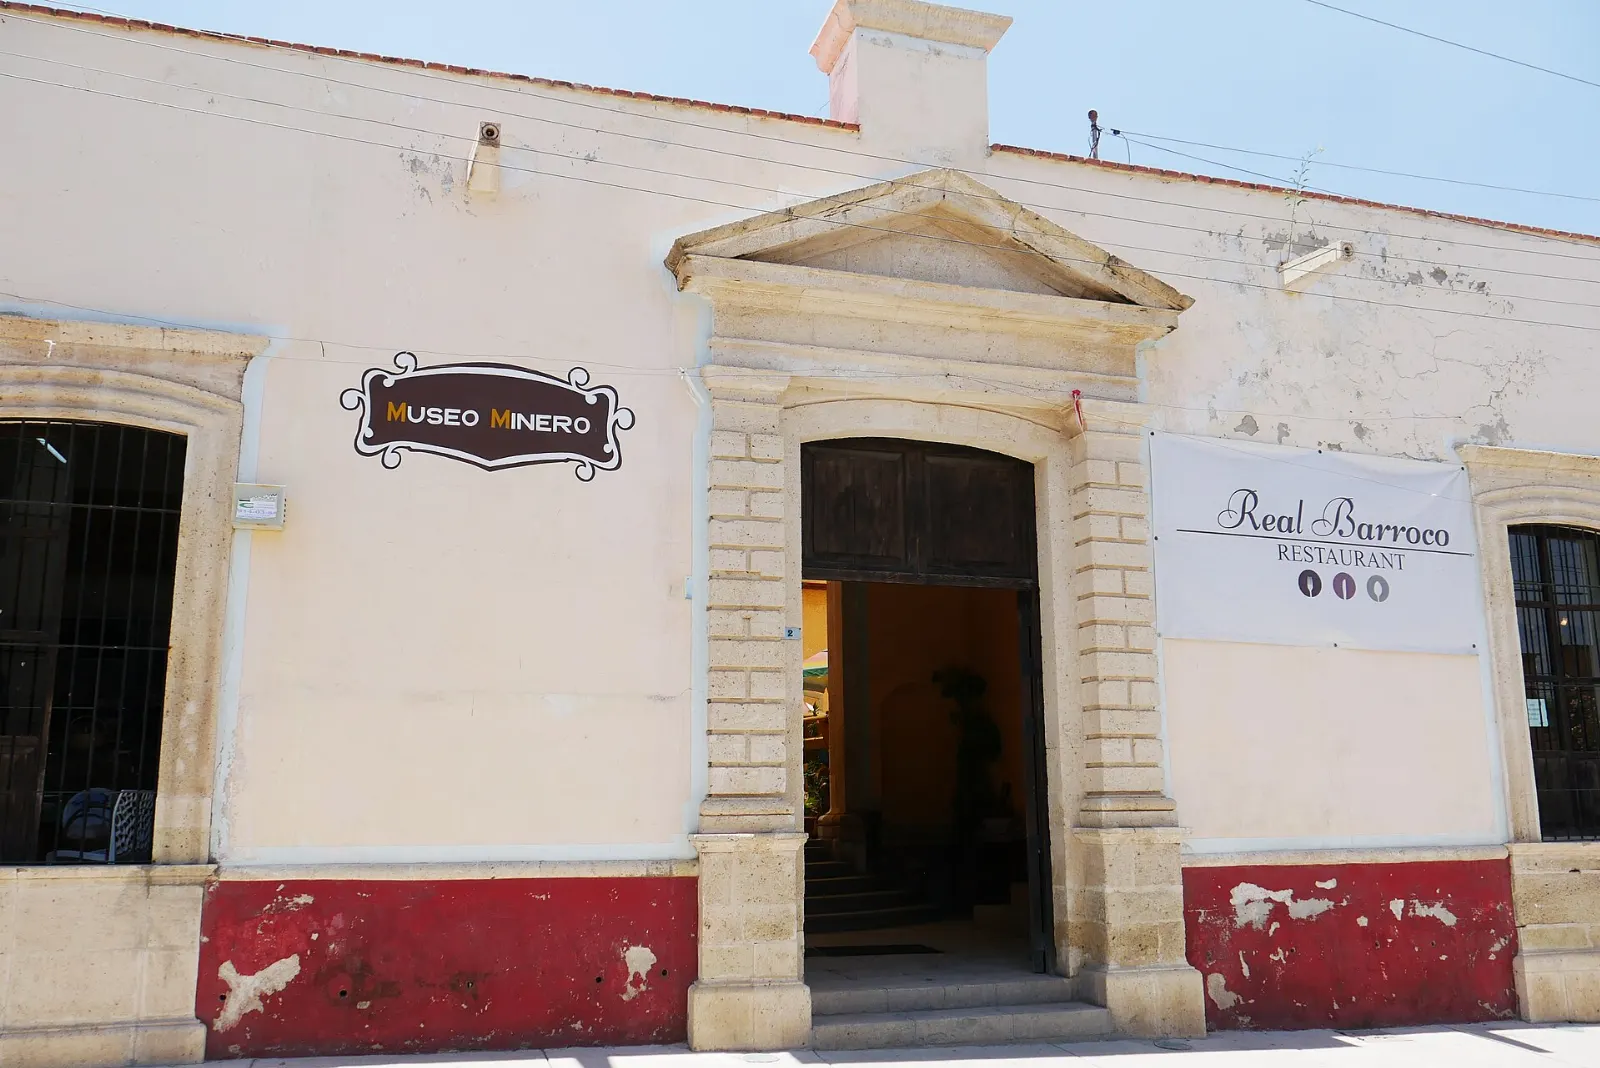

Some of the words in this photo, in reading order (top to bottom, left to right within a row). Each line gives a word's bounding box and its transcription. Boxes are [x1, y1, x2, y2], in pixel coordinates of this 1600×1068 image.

[387, 401, 479, 427] MUSEO
[490, 408, 591, 434] MINERO
[1217, 488, 1303, 535] Real
[1311, 497, 1450, 547] Barroco
[1277, 543, 1405, 571] RESTAURANT
[787, 629, 794, 637] 2
